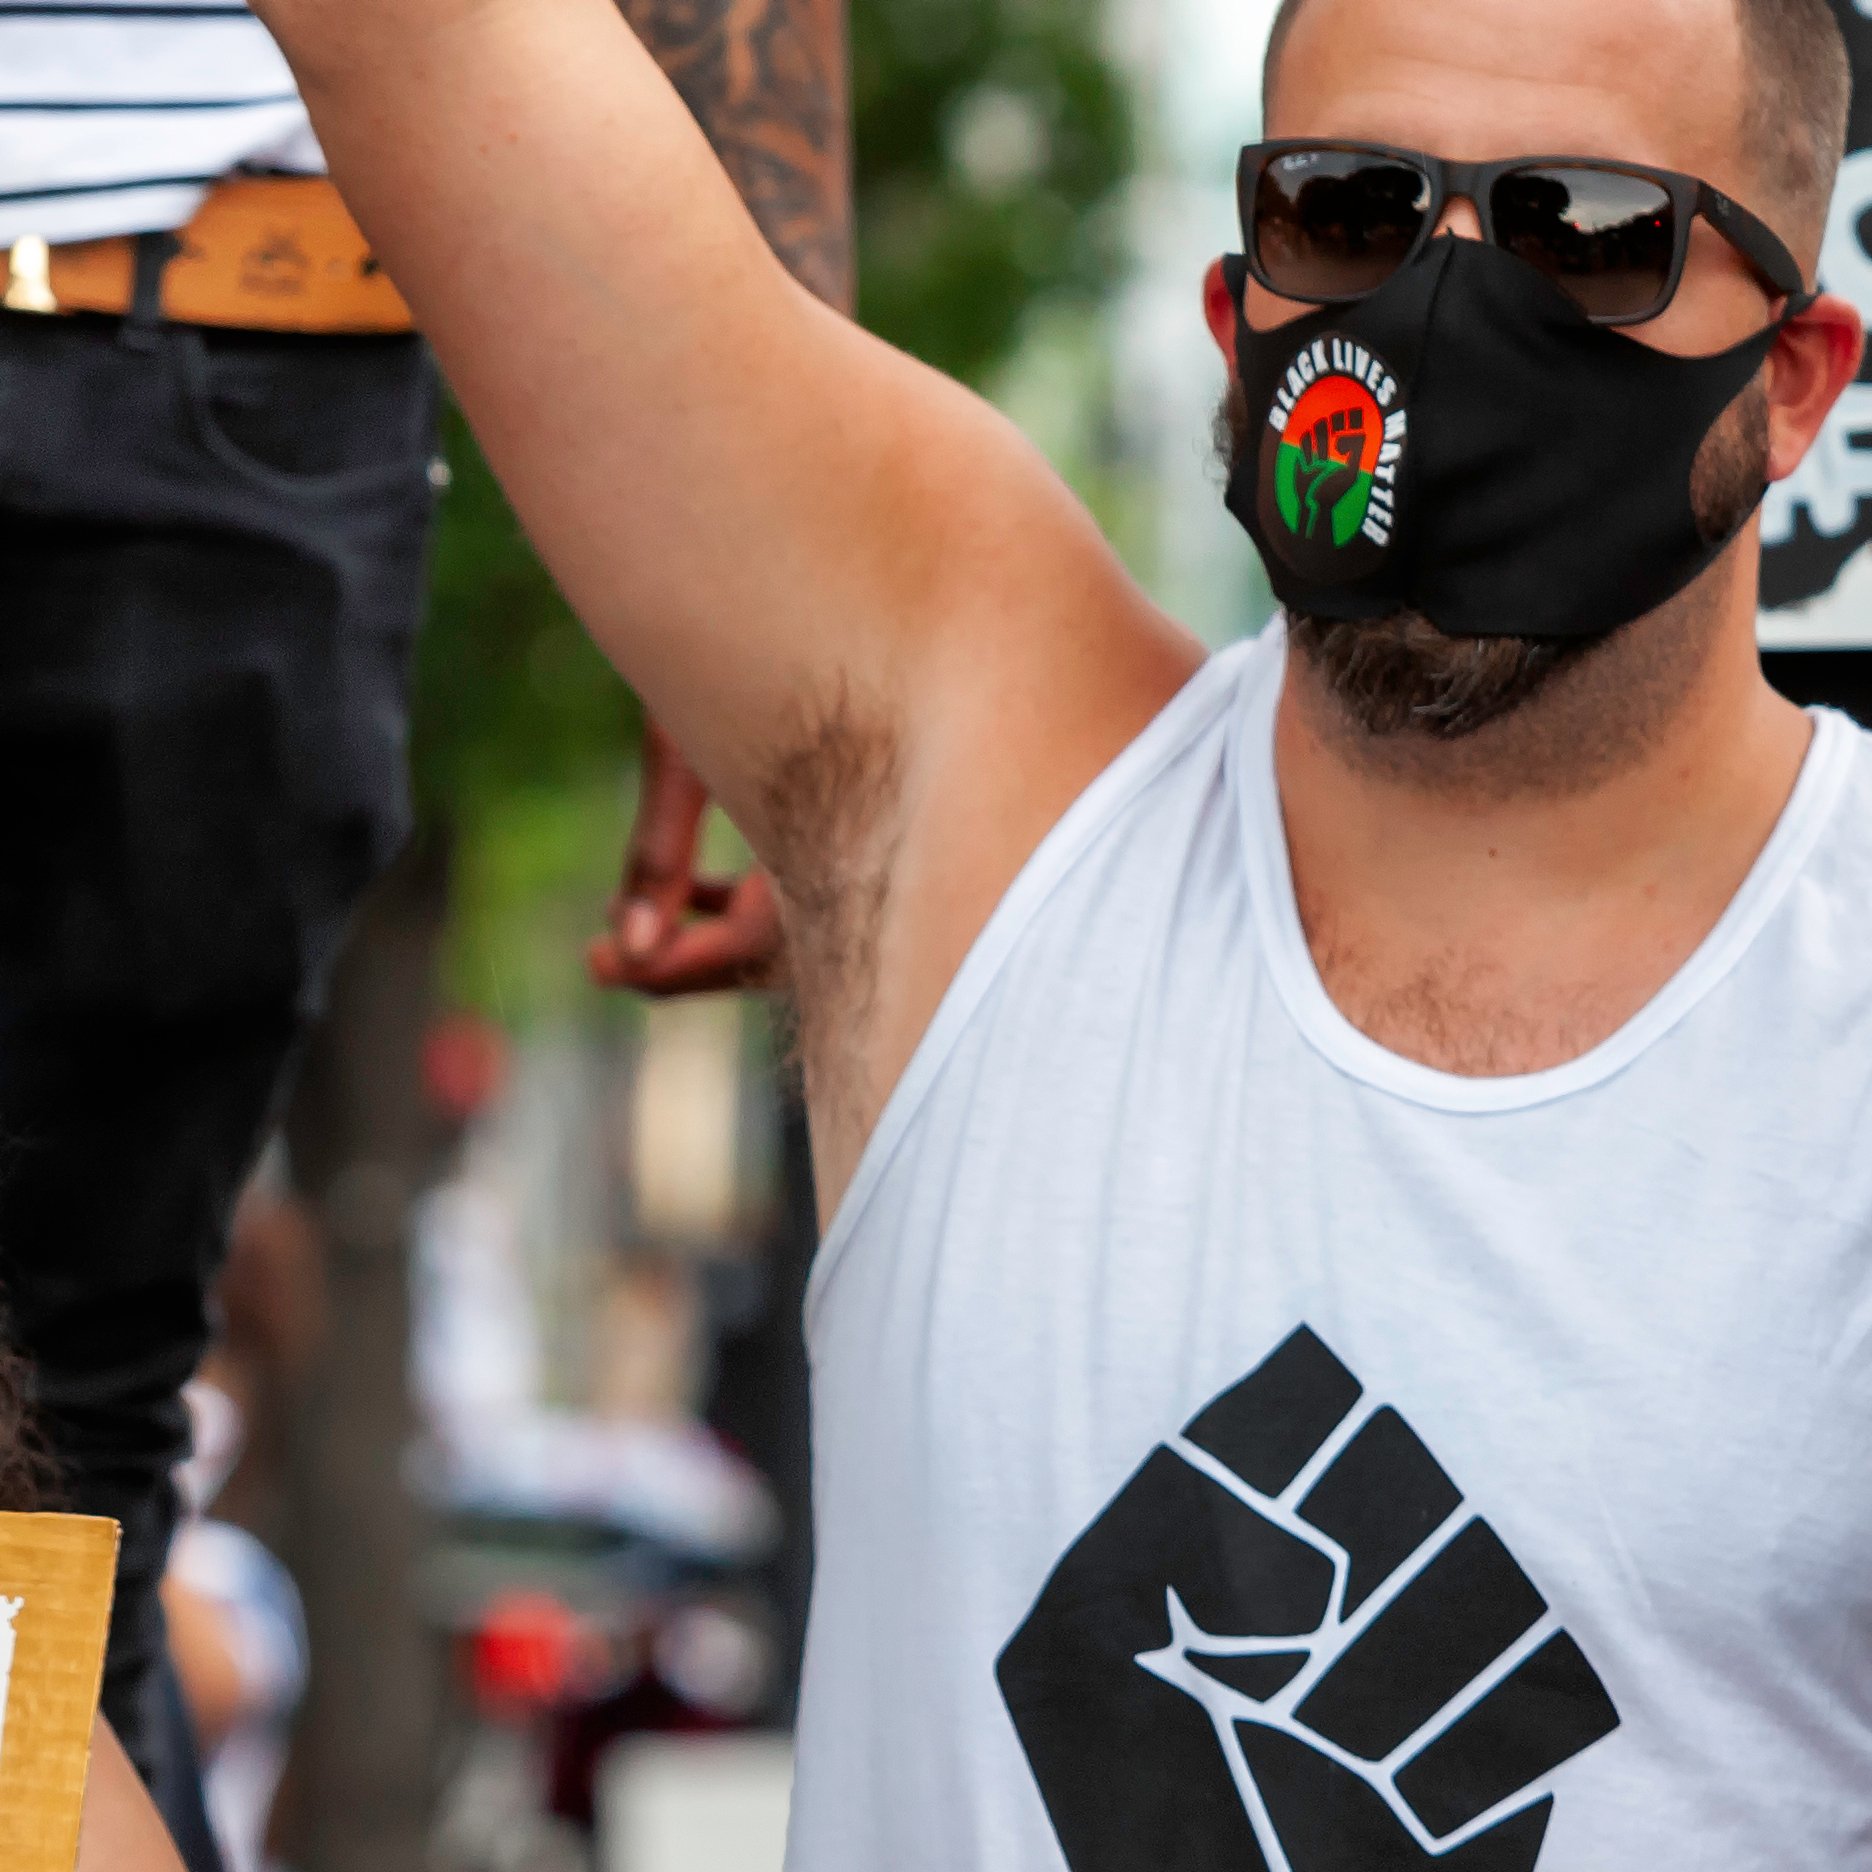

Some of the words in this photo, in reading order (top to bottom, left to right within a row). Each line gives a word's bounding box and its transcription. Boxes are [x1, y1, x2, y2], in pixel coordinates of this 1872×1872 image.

[1268, 338, 1329, 433] BLACK
[1332, 337, 1397, 407] LIVES
[1360, 409, 1407, 547] MATTER
